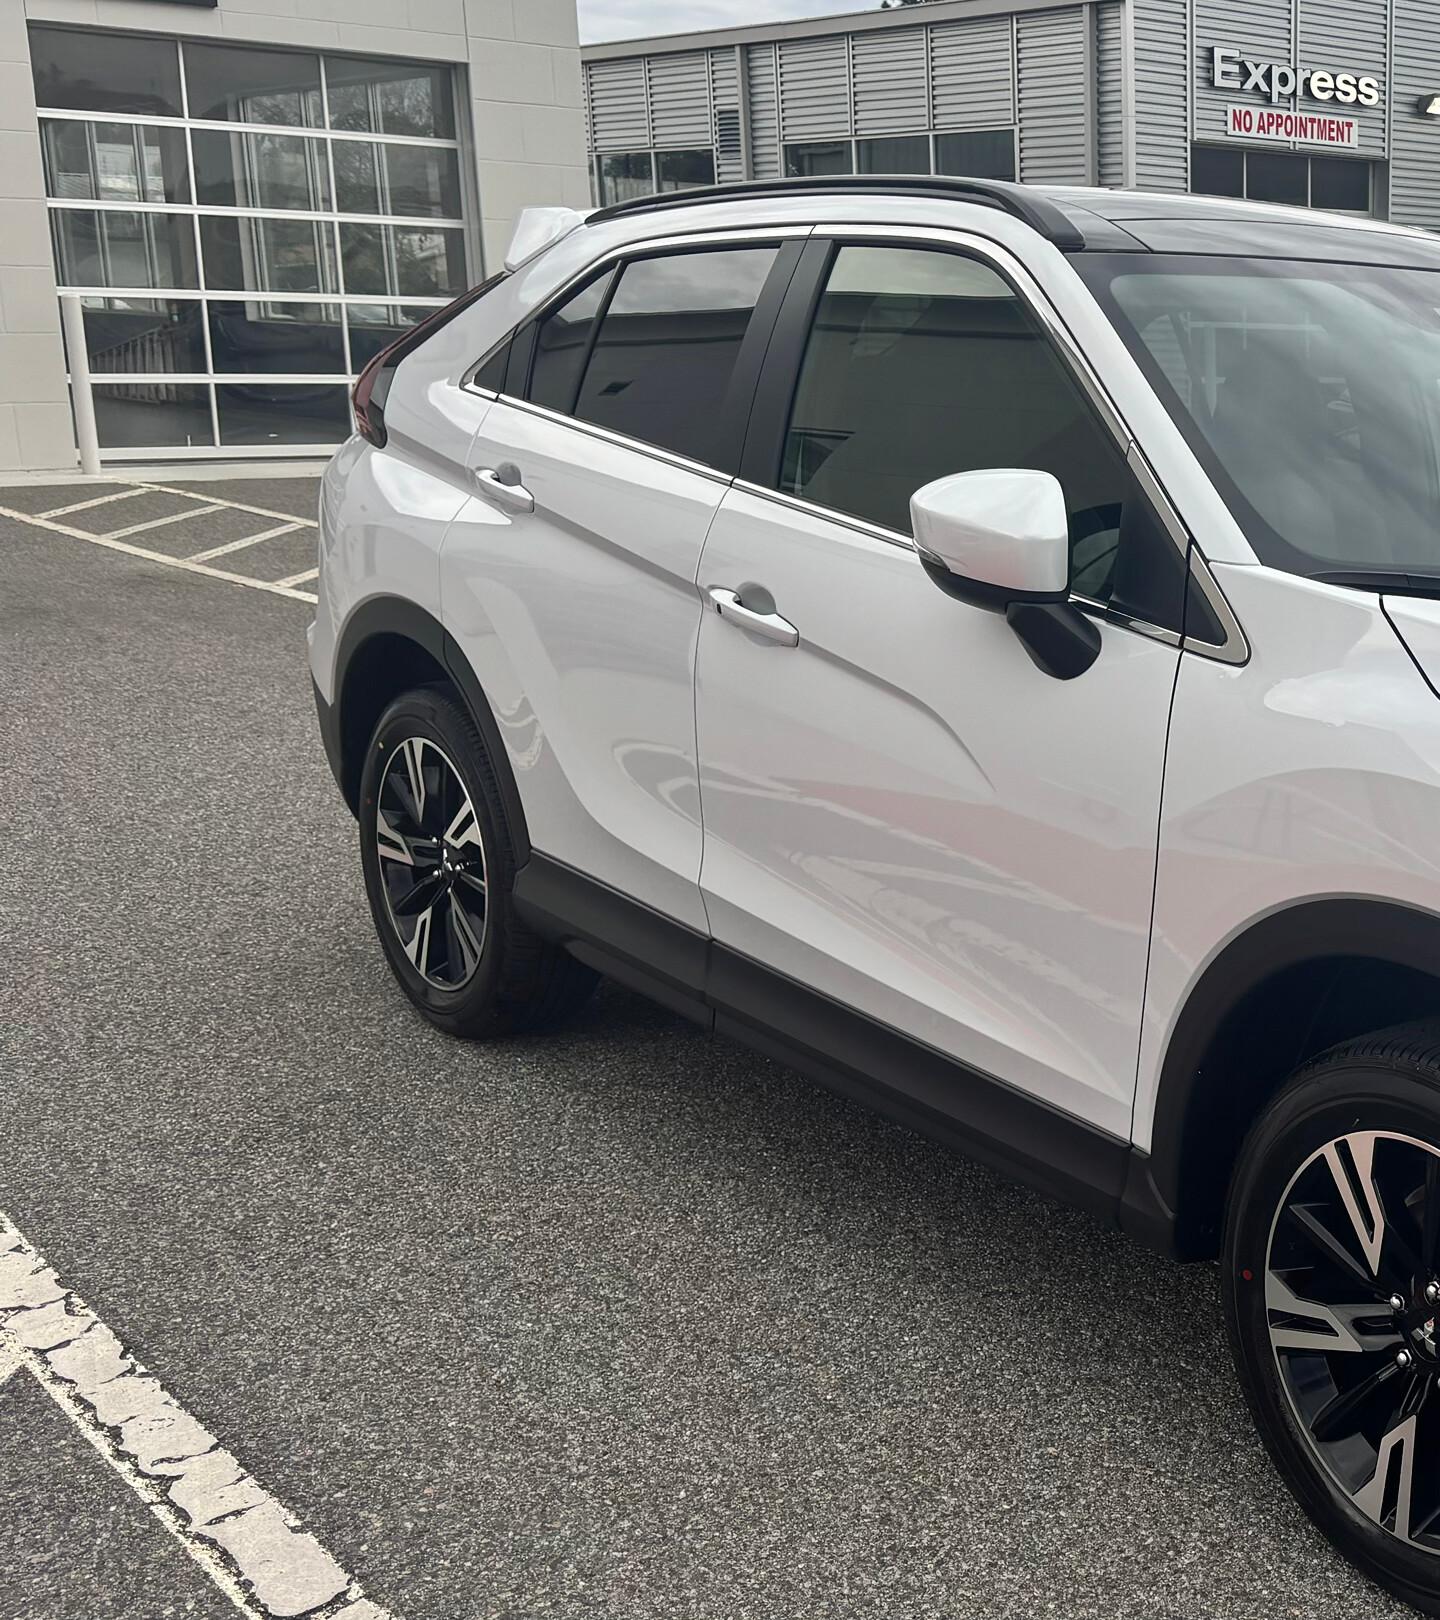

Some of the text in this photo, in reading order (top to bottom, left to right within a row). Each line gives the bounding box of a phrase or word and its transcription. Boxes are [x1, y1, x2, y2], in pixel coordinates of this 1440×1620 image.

[1212, 45, 1380, 106] Express
[1231, 108, 1354, 143] NO APPOINTMENT
